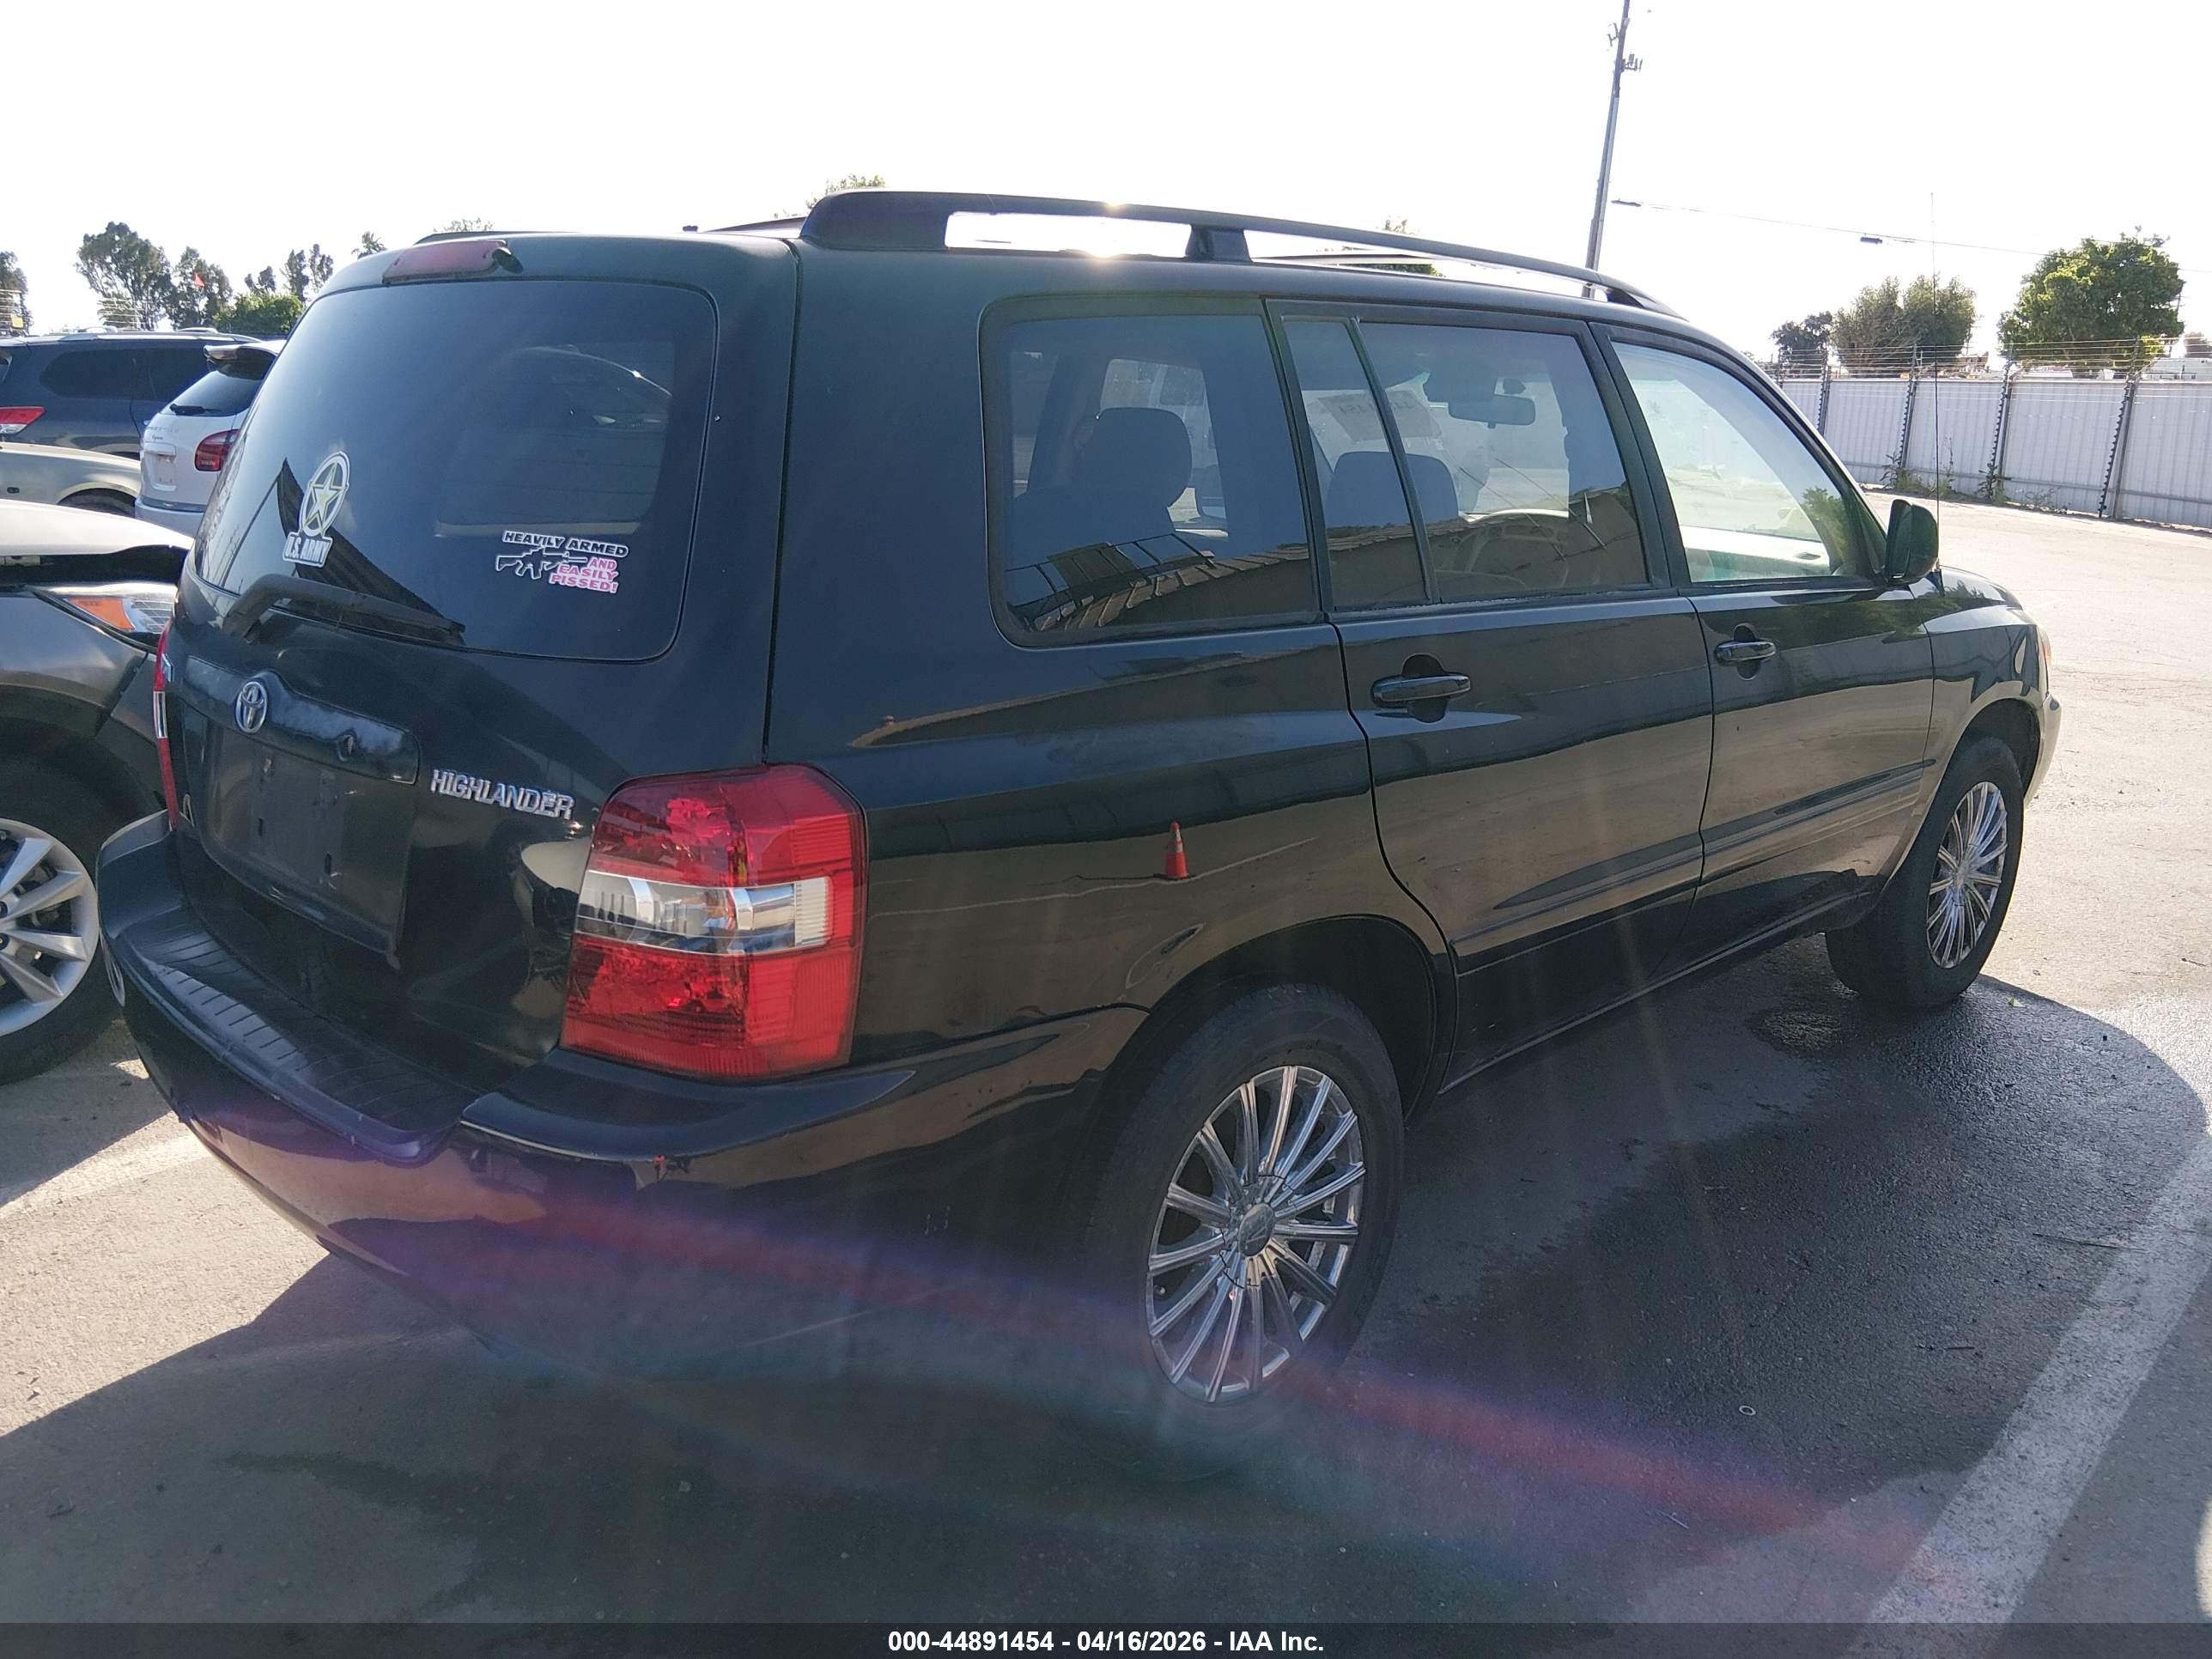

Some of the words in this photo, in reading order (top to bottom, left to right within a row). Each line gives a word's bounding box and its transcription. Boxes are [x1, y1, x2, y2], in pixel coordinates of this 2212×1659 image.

[285, 536, 301, 558] U.S.
[300, 538, 331, 563] ARMY
[503, 531, 565, 548] HEAVILY
[568, 539, 628, 556] ARMED
[558, 564, 618, 581] EASILY
[589, 558, 617, 570] AND
[550, 574, 618, 592] PISSED!
[431, 769, 574, 819] HIGHLANDER
